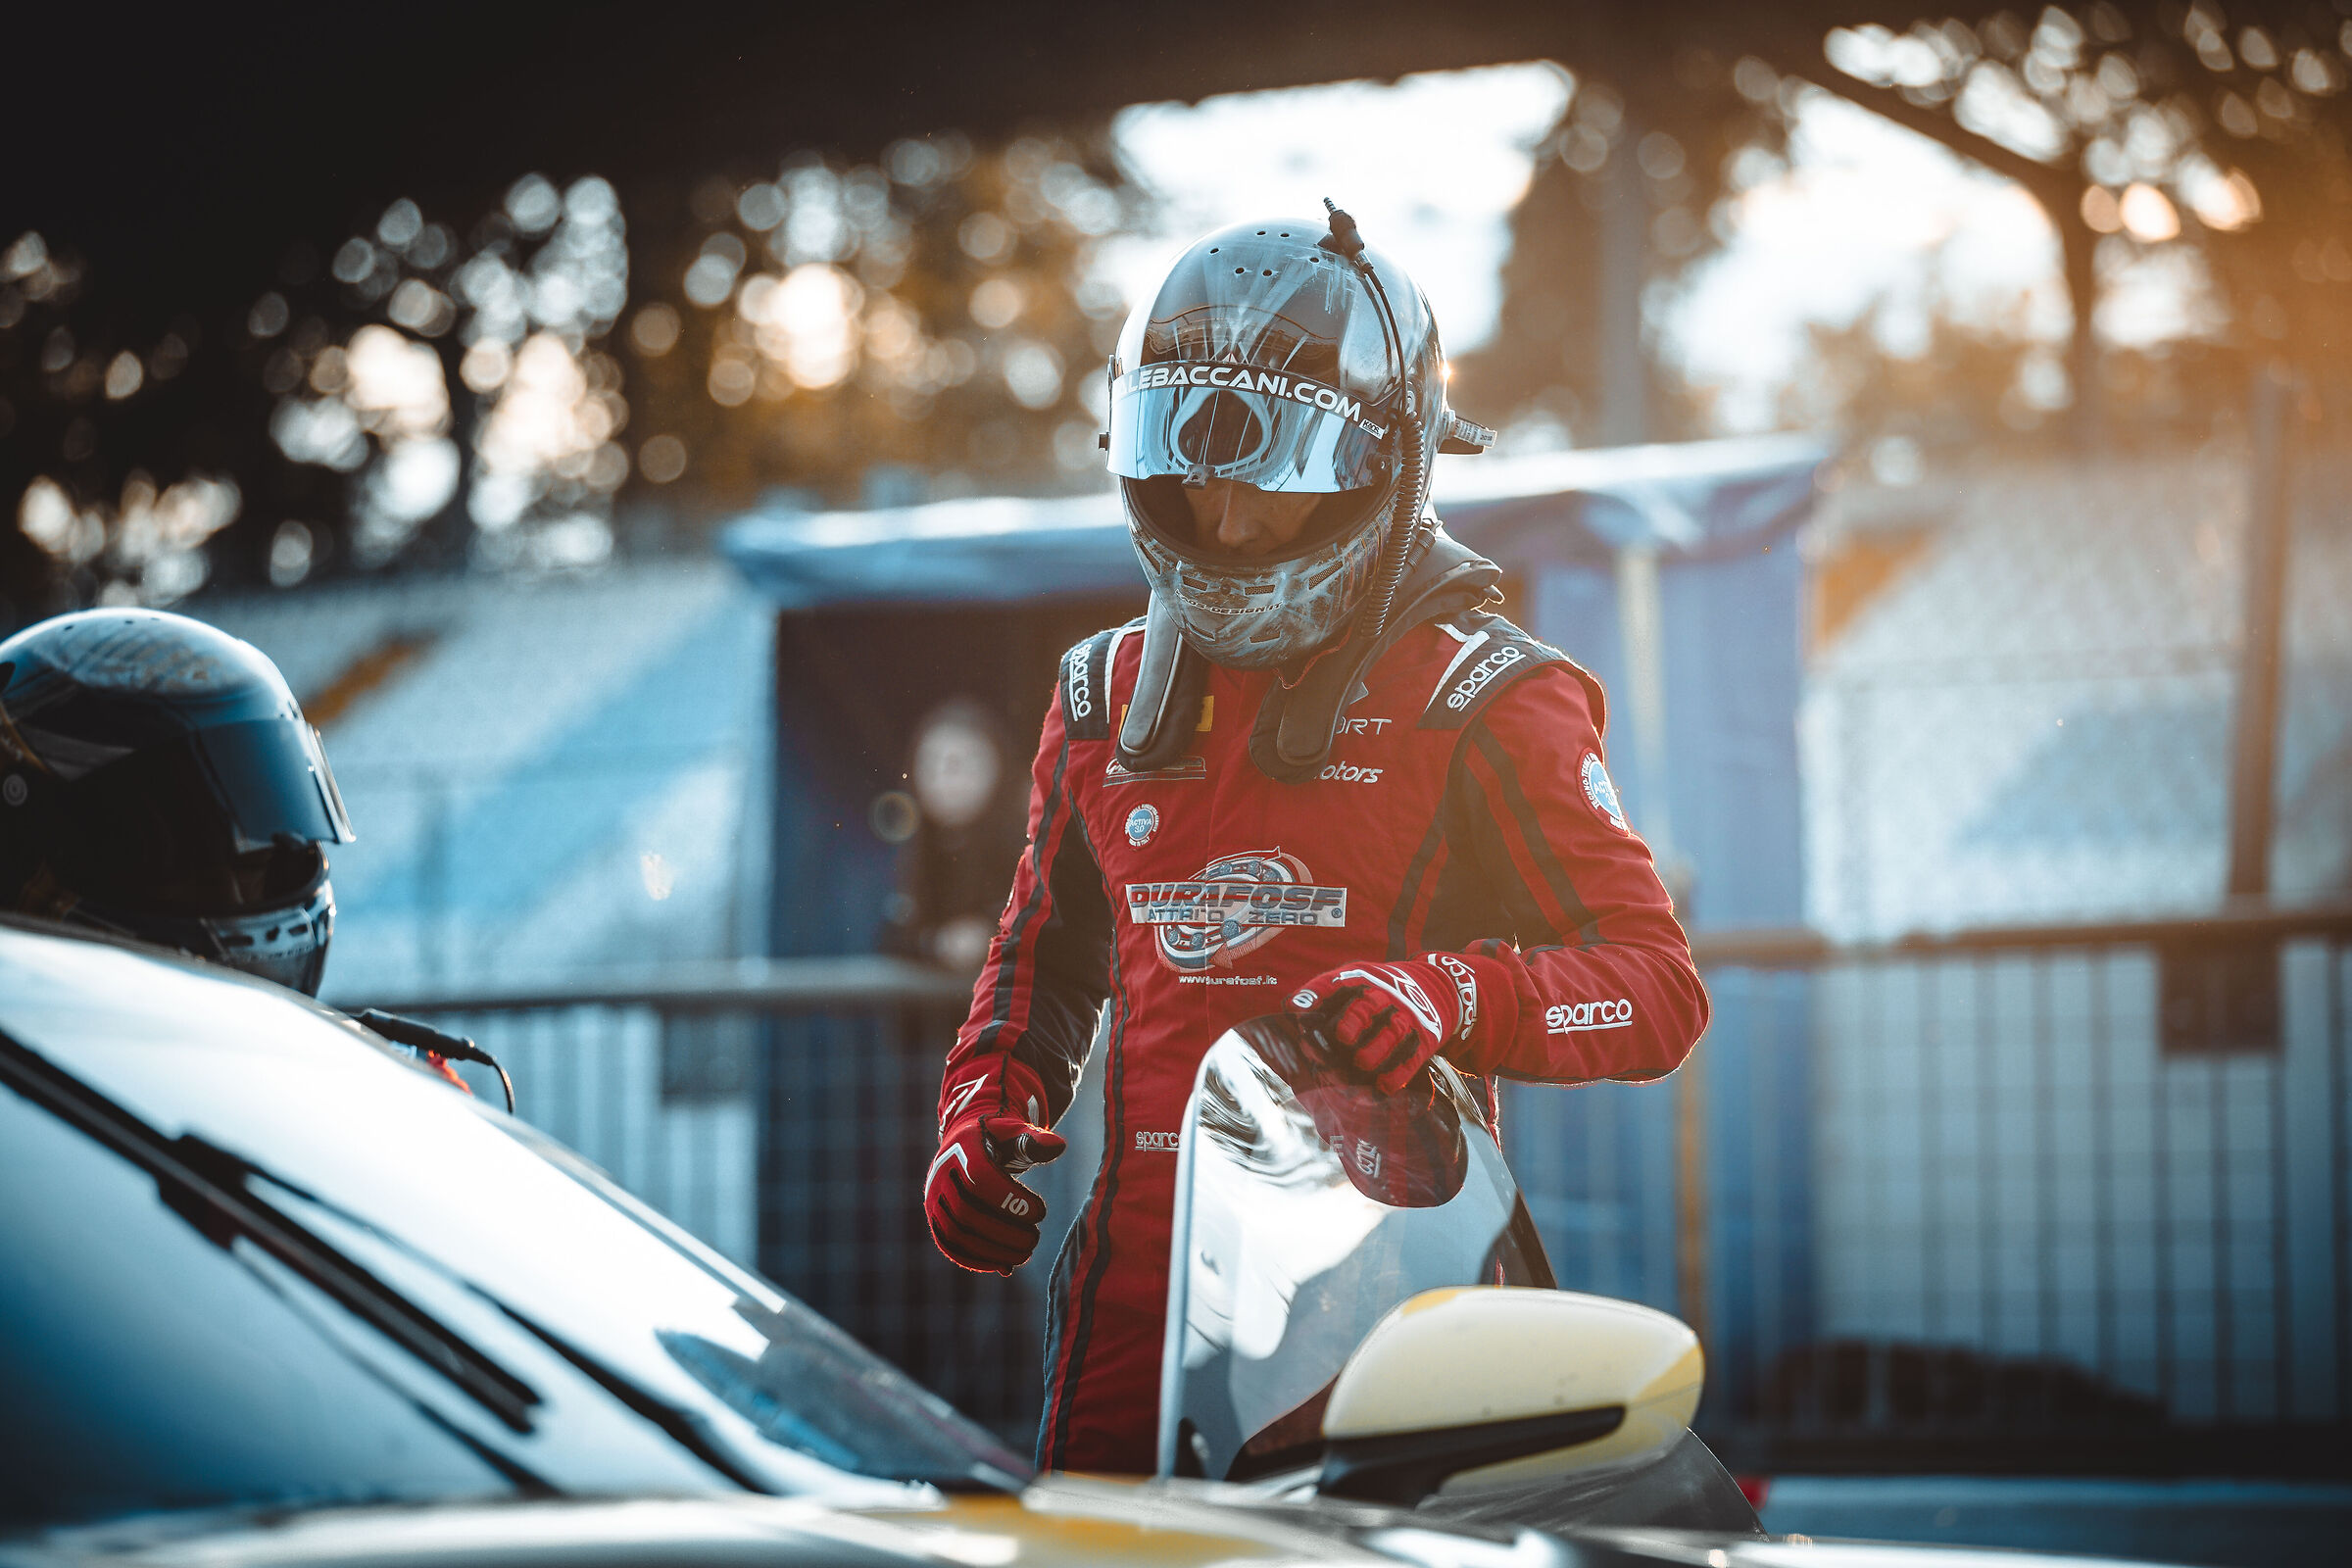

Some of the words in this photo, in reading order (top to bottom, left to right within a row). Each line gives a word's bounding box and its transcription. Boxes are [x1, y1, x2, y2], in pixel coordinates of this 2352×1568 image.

[1069, 643, 1093, 721] sparco
[1446, 645, 1526, 712] sparco
[1131, 885, 1344, 911] DURAFOSF
[1248, 910, 1319, 925] ZERO
[1545, 998, 1634, 1035] sparco
